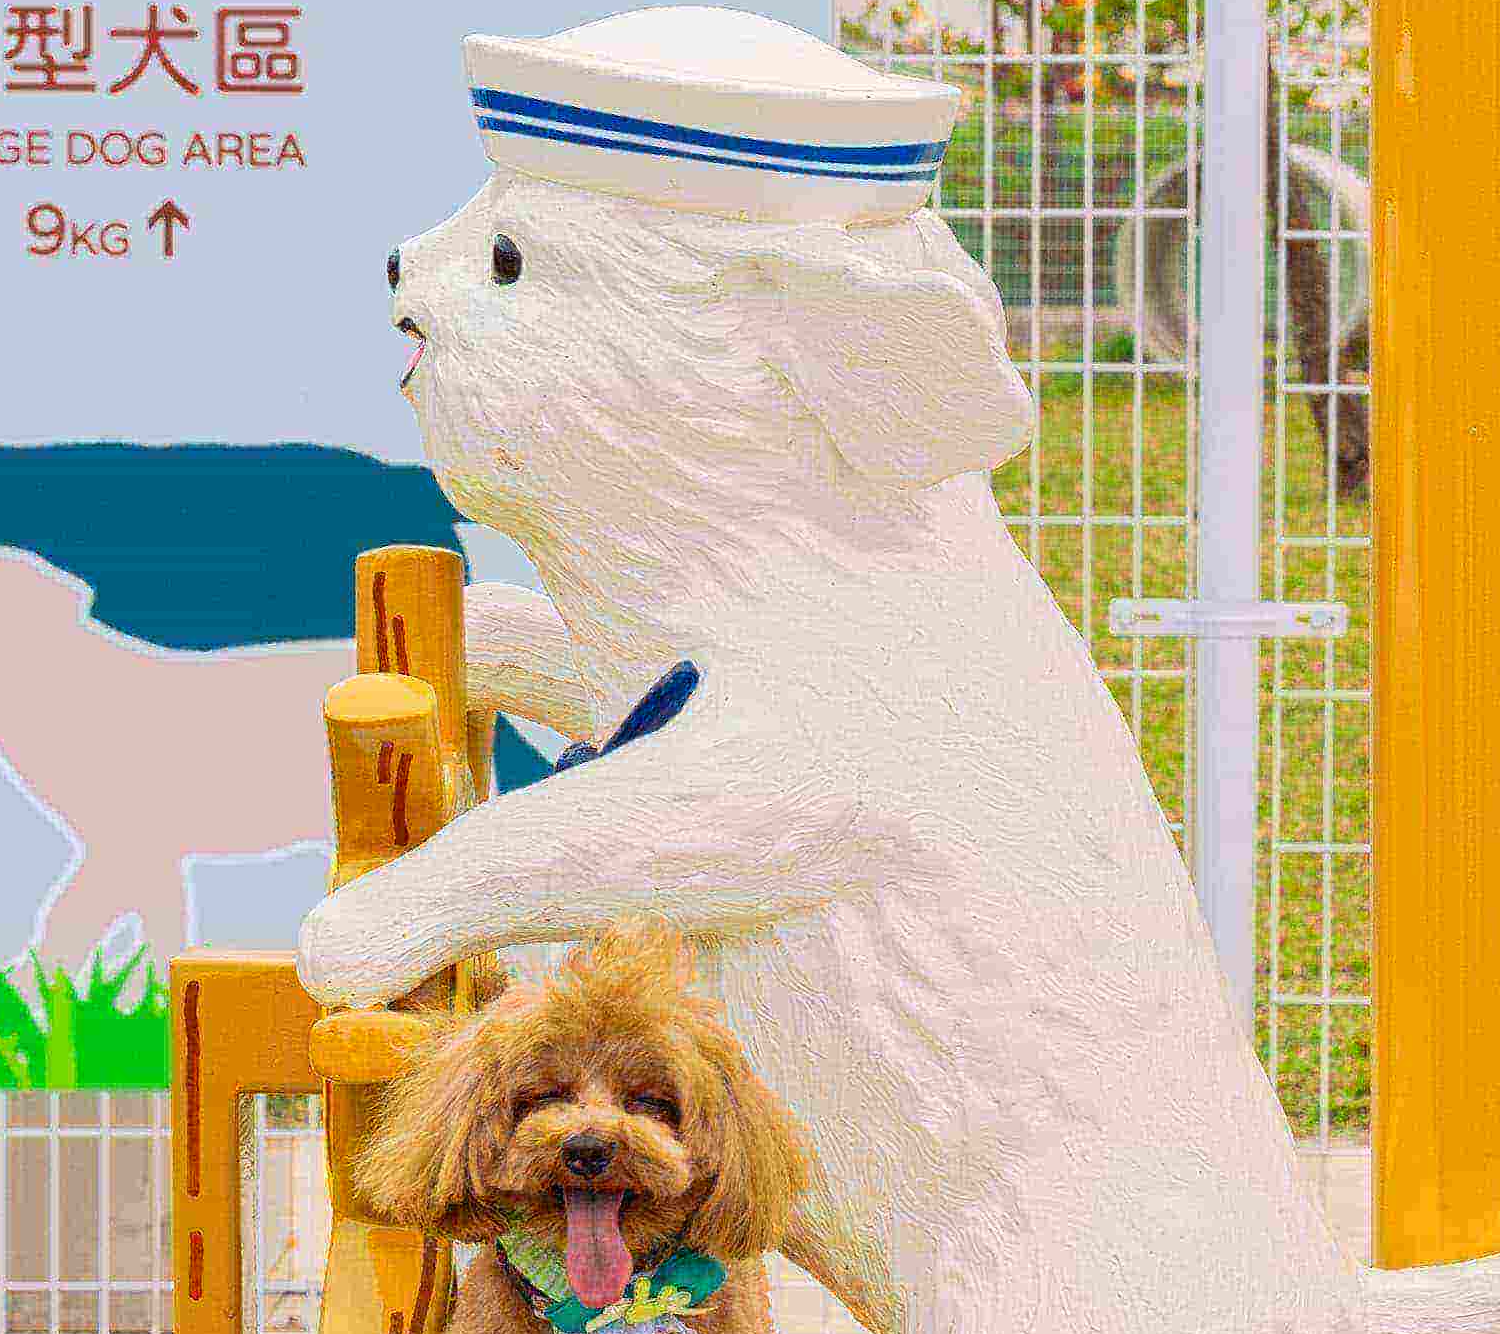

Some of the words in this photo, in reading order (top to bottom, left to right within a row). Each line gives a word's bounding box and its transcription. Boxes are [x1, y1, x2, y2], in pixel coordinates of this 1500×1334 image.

[65, 131, 167, 166] DOG
[182, 132, 306, 167] AREA
[26, 203, 131, 256] 9KG
